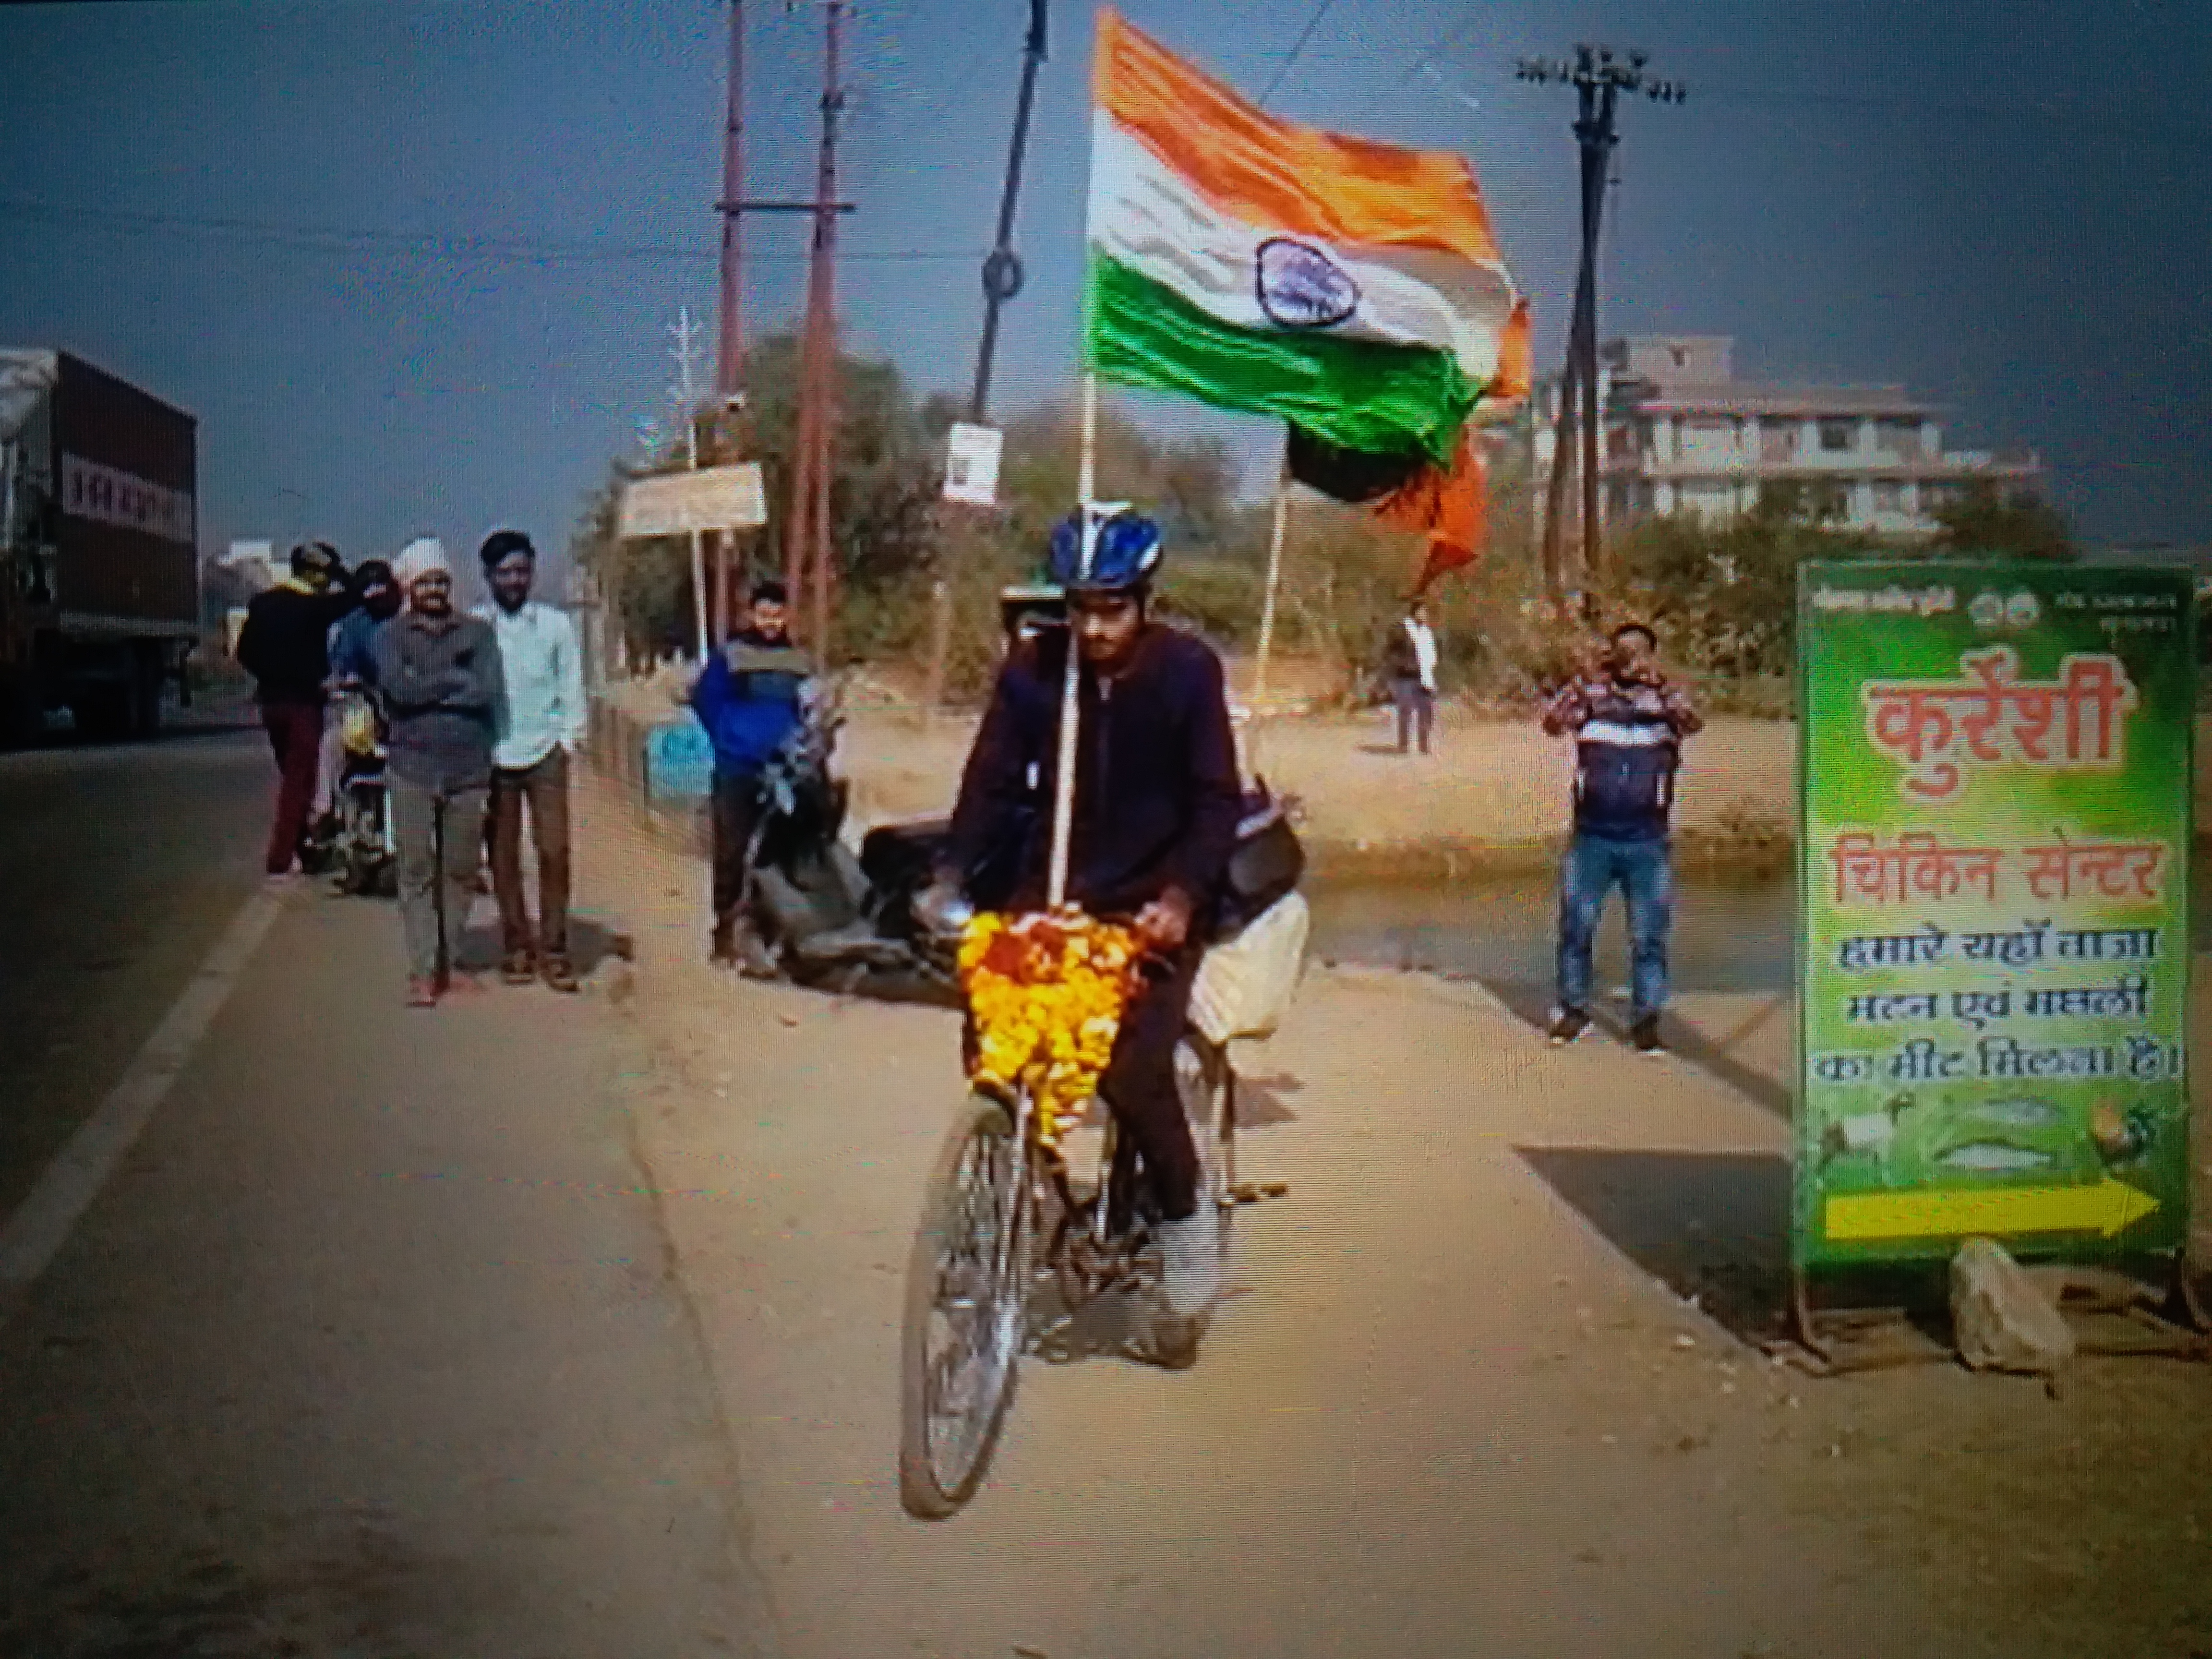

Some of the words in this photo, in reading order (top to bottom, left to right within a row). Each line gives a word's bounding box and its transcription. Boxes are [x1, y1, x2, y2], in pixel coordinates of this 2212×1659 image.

[1830, 831, 2004, 902] चिकिन
[1839, 922, 1947, 967] हमारे
[2057, 929, 2159, 958] ताजा
[1848, 993, 1938, 1020] मटन
[1890, 1038, 1962, 1079] मीट
[1976, 1035, 2114, 1076] मिलता
